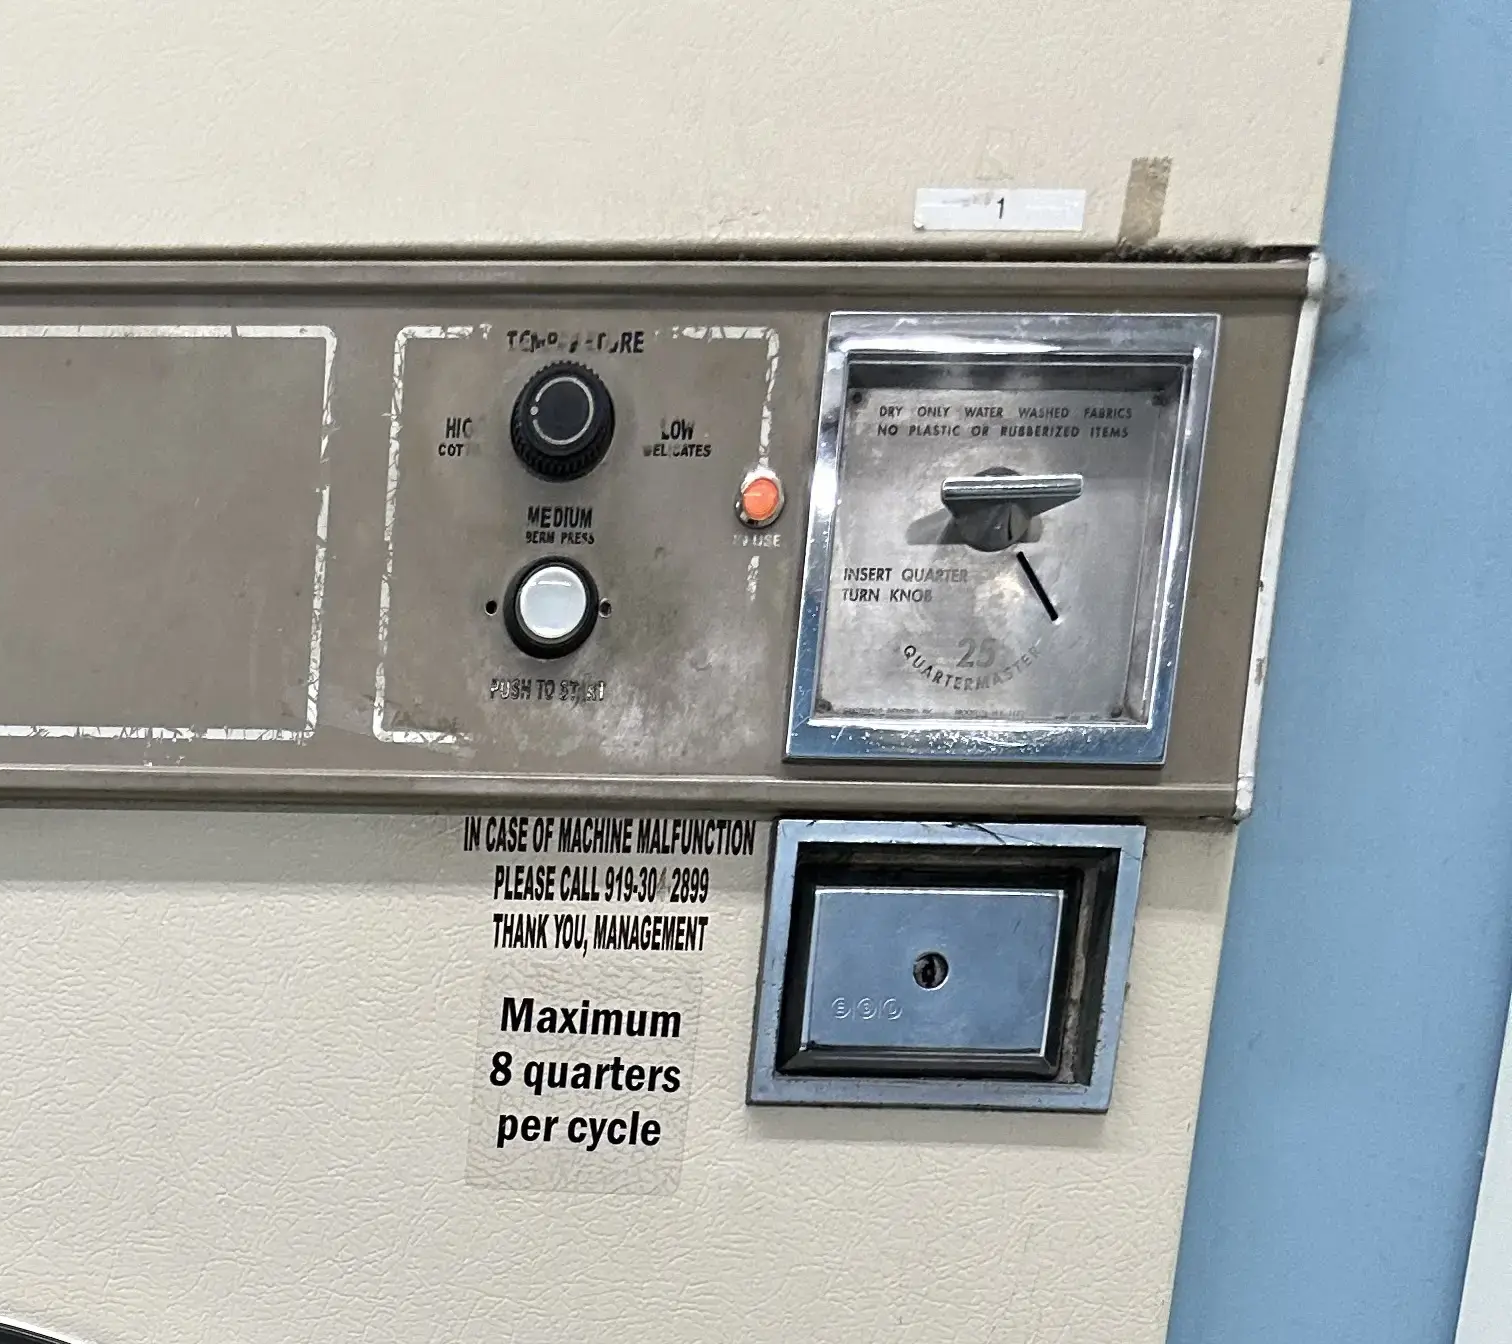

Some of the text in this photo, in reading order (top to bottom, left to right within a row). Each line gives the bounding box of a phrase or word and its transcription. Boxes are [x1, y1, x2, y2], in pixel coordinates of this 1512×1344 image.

[996, 197, 1005, 220] 1
[879, 406, 1133, 420] DRY ONLY WATER WASHED FABRICS
[660, 418, 694, 441] LOW
[877, 425, 1129, 438] NO PLASTIC OR RUBBERIZED ITEMS
[527, 505, 593, 529] MEDIUM
[560, 531, 595, 545] PRESS
[752, 534, 781, 548] USE
[843, 567, 968, 583] INSERT QUARTER
[842, 588, 933, 602] TURN KNOB
[955, 637, 996, 668] 25
[903, 644, 1040, 692] QUARTERMASTER
[490, 678, 532, 701] PUSH
[535, 679, 555, 701] TO
[463, 816, 756, 856] IN CASE OF MACHINE MALFUNCTION
[493, 865, 556, 901] PLEASE
[560, 865, 600, 901] CALL
[493, 913, 709, 958] THANK YOU, MANAGEMENT
[500, 996, 682, 1038] Maximum
[489, 1051, 681, 1093] 8 quarters
[496, 1110, 661, 1151] per cycle
